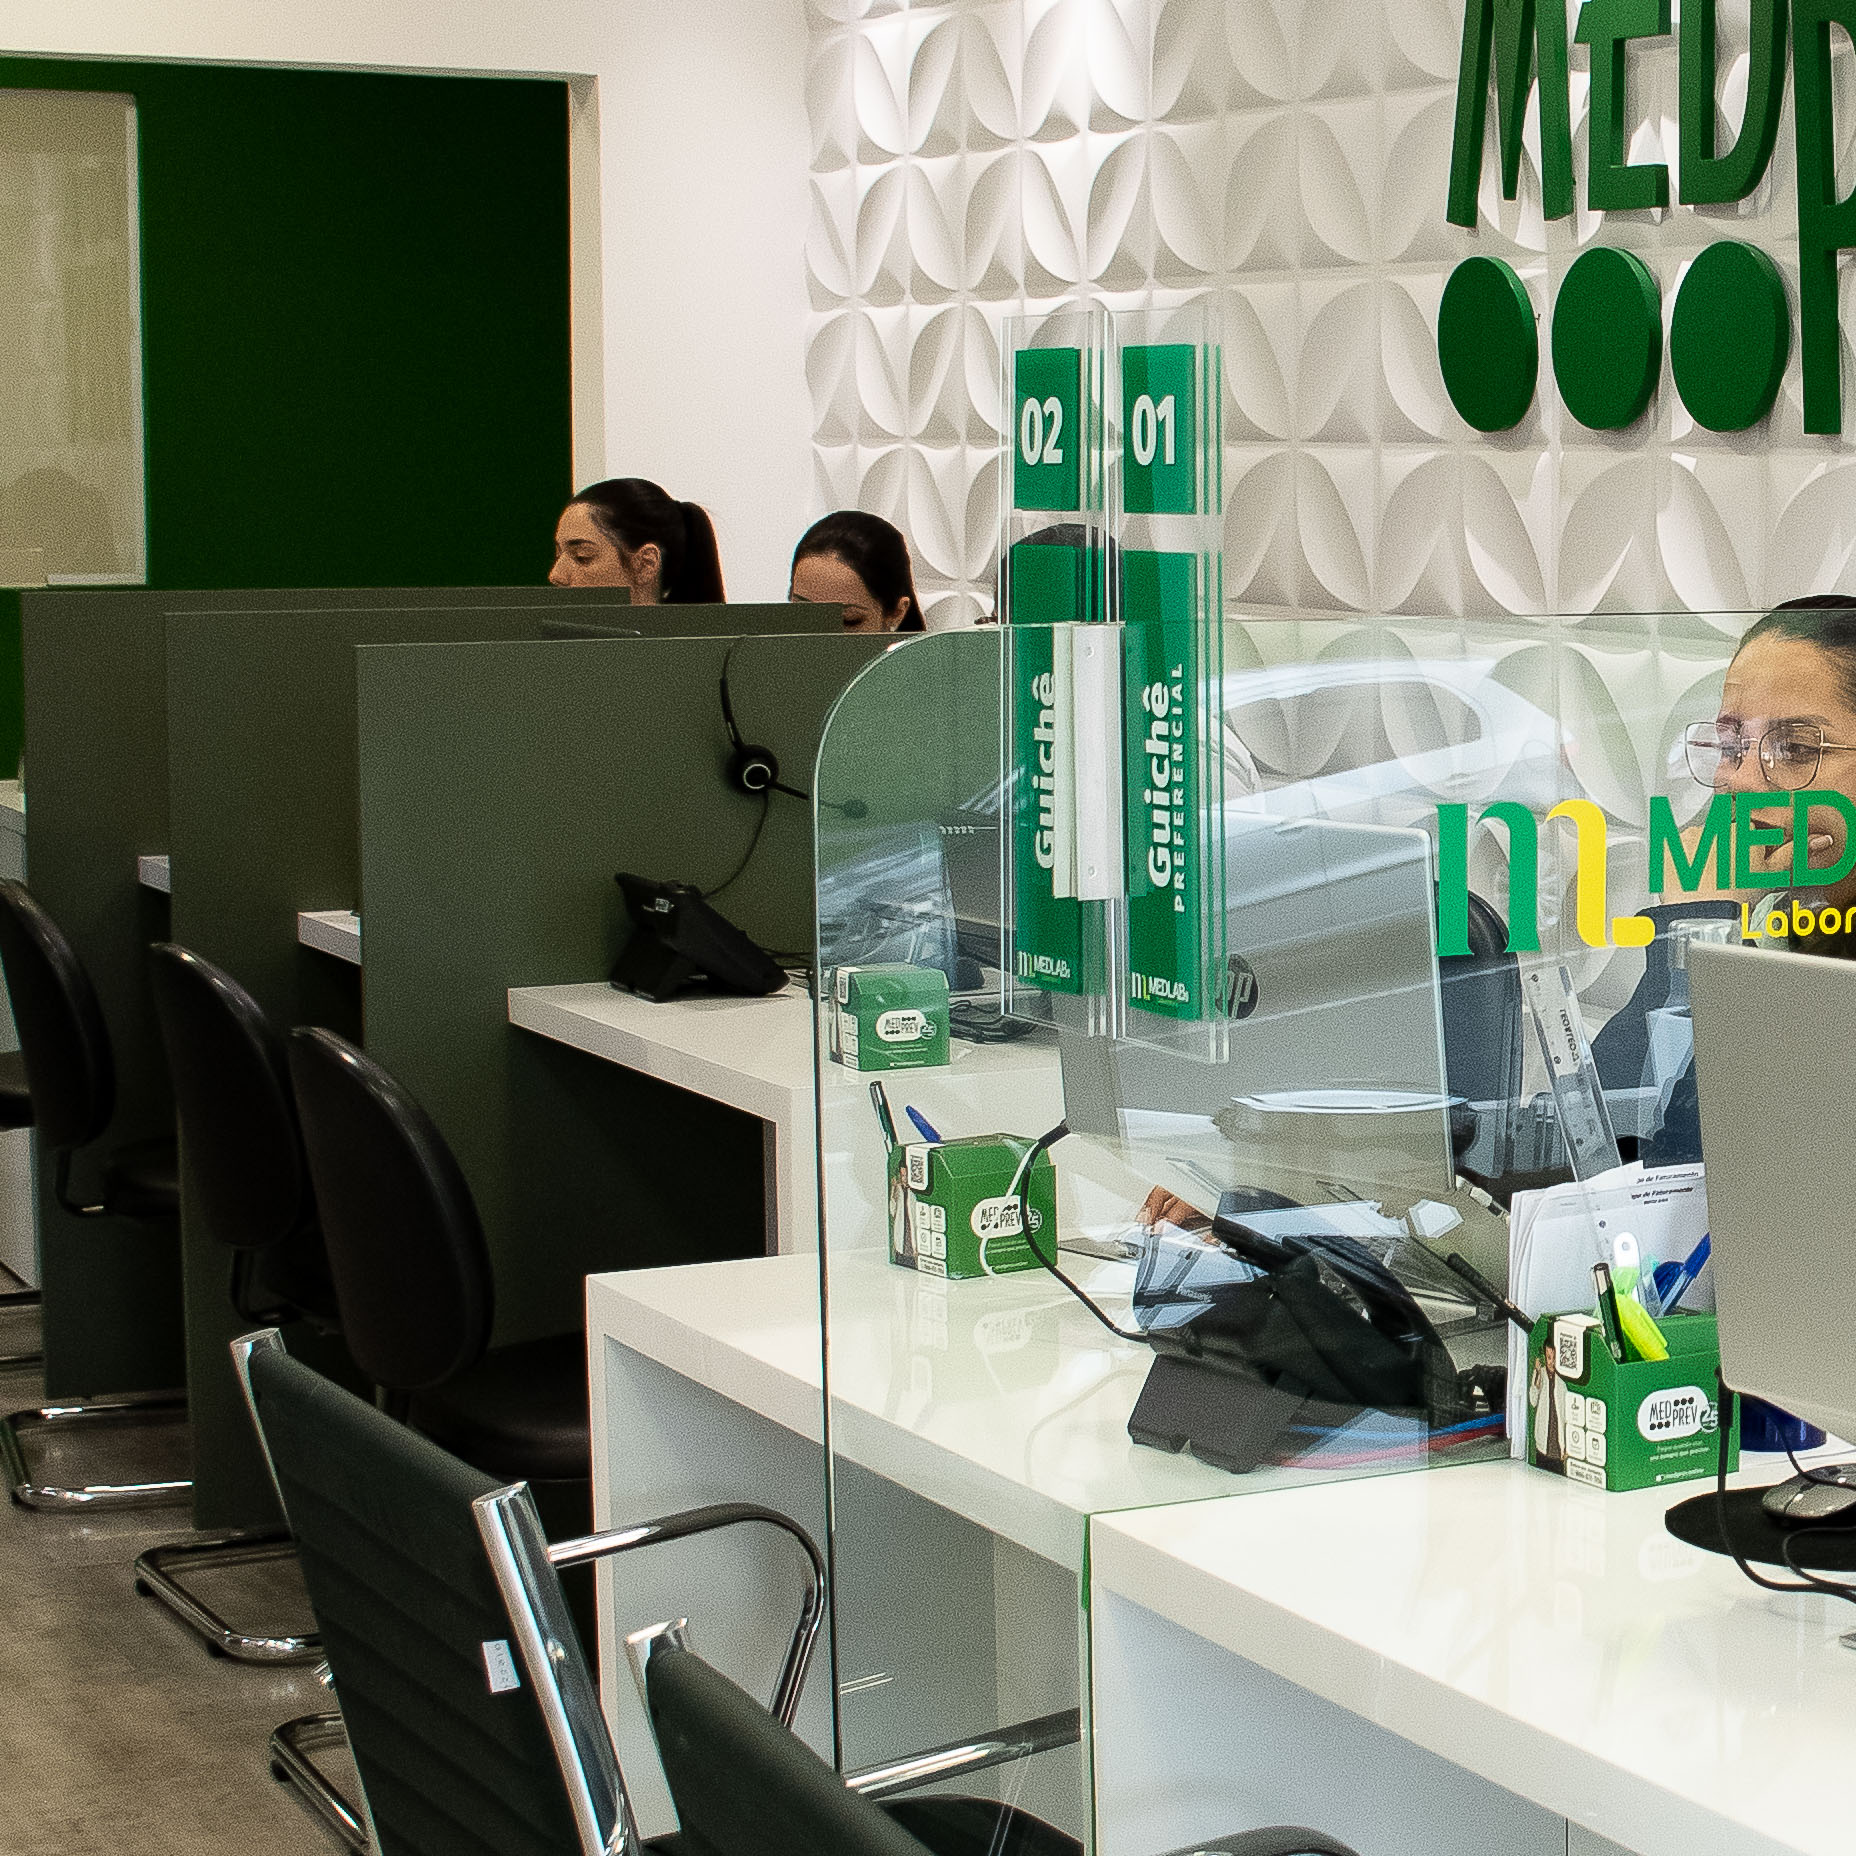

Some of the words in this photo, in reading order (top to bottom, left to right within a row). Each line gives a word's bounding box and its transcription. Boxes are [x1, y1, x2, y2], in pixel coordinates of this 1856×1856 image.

[1020, 397, 1063, 465] 02
[1131, 394, 1176, 467] 01
[1142, 681, 1172, 888] Guichê
[1171, 663, 1186, 913] PREFERENCIAL
[1649, 1400, 1672, 1422] MED
[1672, 1405, 1698, 1427] PREV
